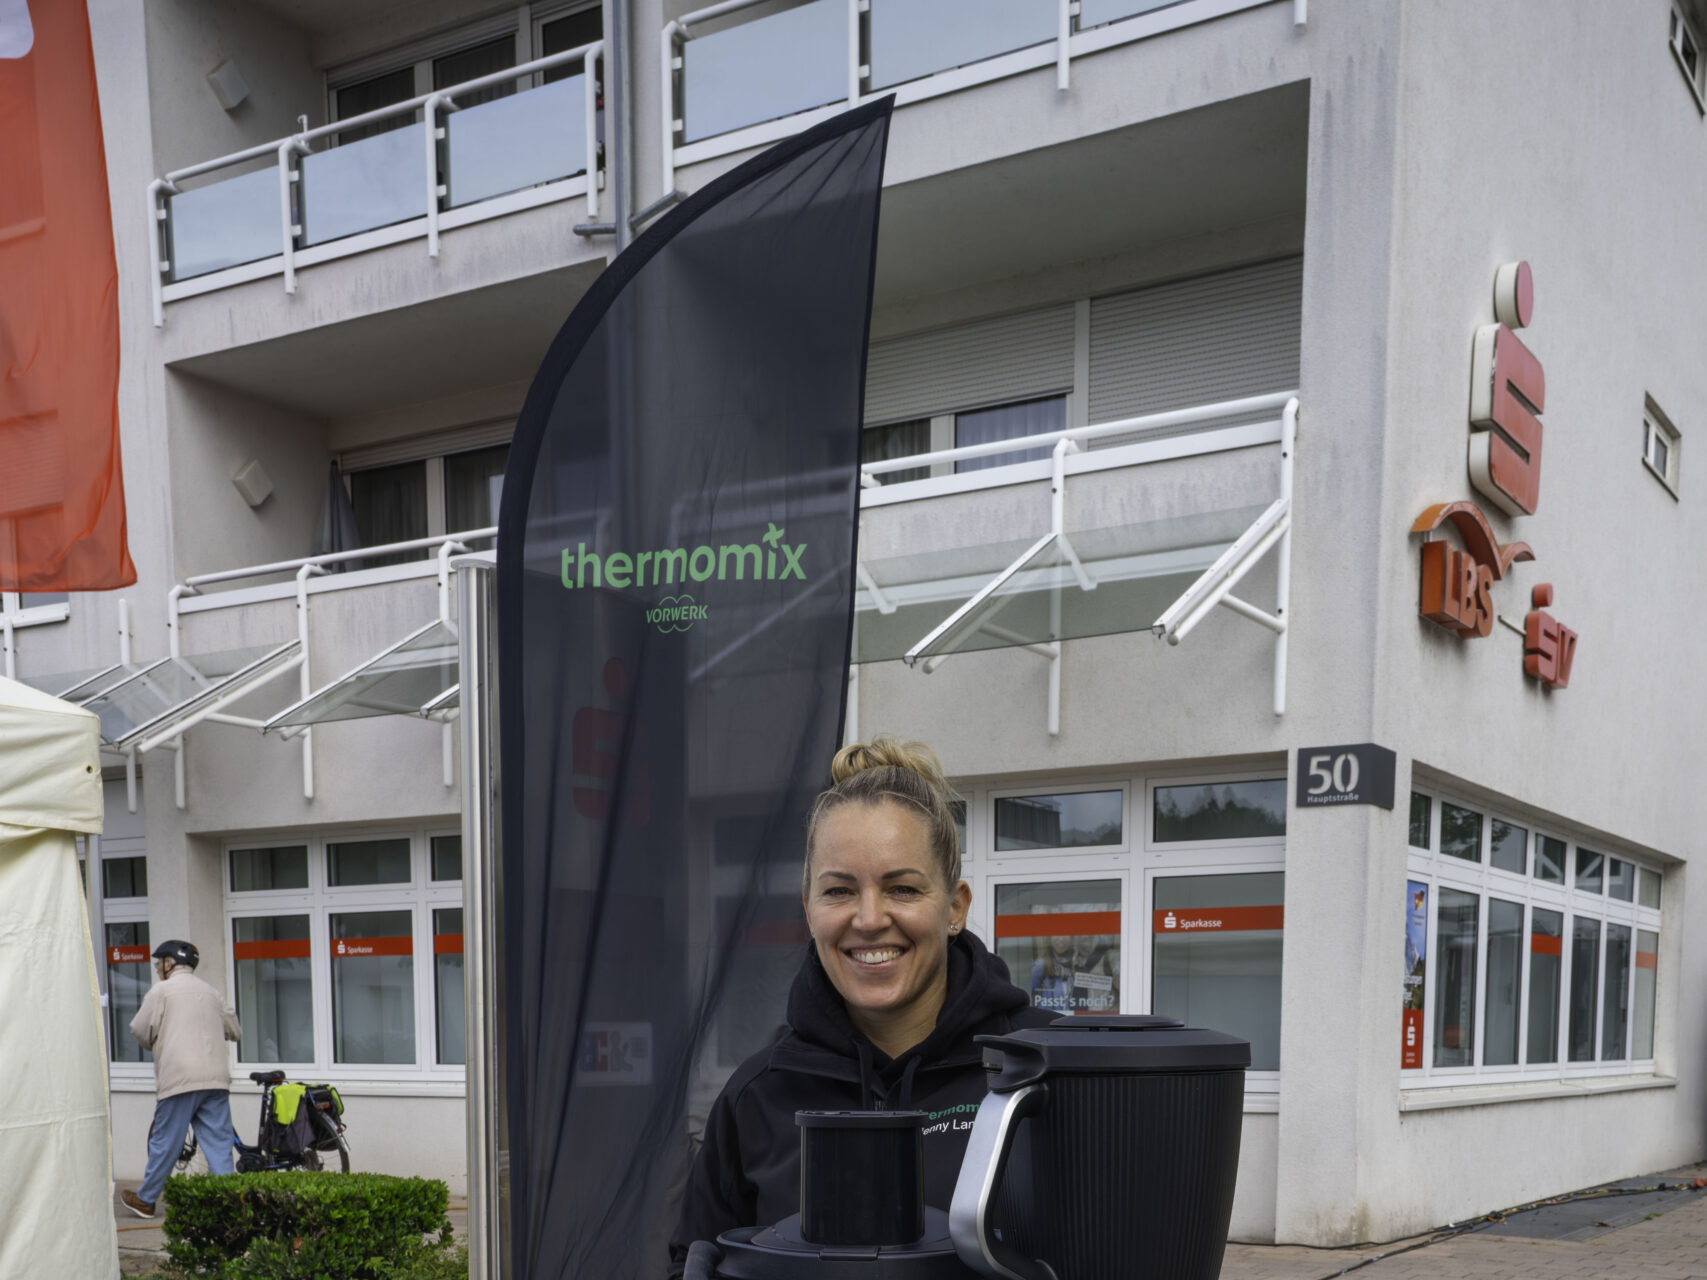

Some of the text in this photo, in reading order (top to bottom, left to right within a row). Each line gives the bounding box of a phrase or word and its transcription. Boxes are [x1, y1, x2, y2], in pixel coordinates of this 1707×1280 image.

[561, 522, 808, 589] thermomix
[1422, 540, 1494, 639] LBS
[646, 604, 708, 624] VORWERK
[1308, 753, 1359, 795] 50
[1307, 793, 1359, 804] Hauptstraße
[1180, 918, 1222, 930] Sparkasse
[347, 946, 373, 954] Sparkasse
[1079, 995, 1115, 1008] noch?
[922, 1121, 949, 1135] enny
